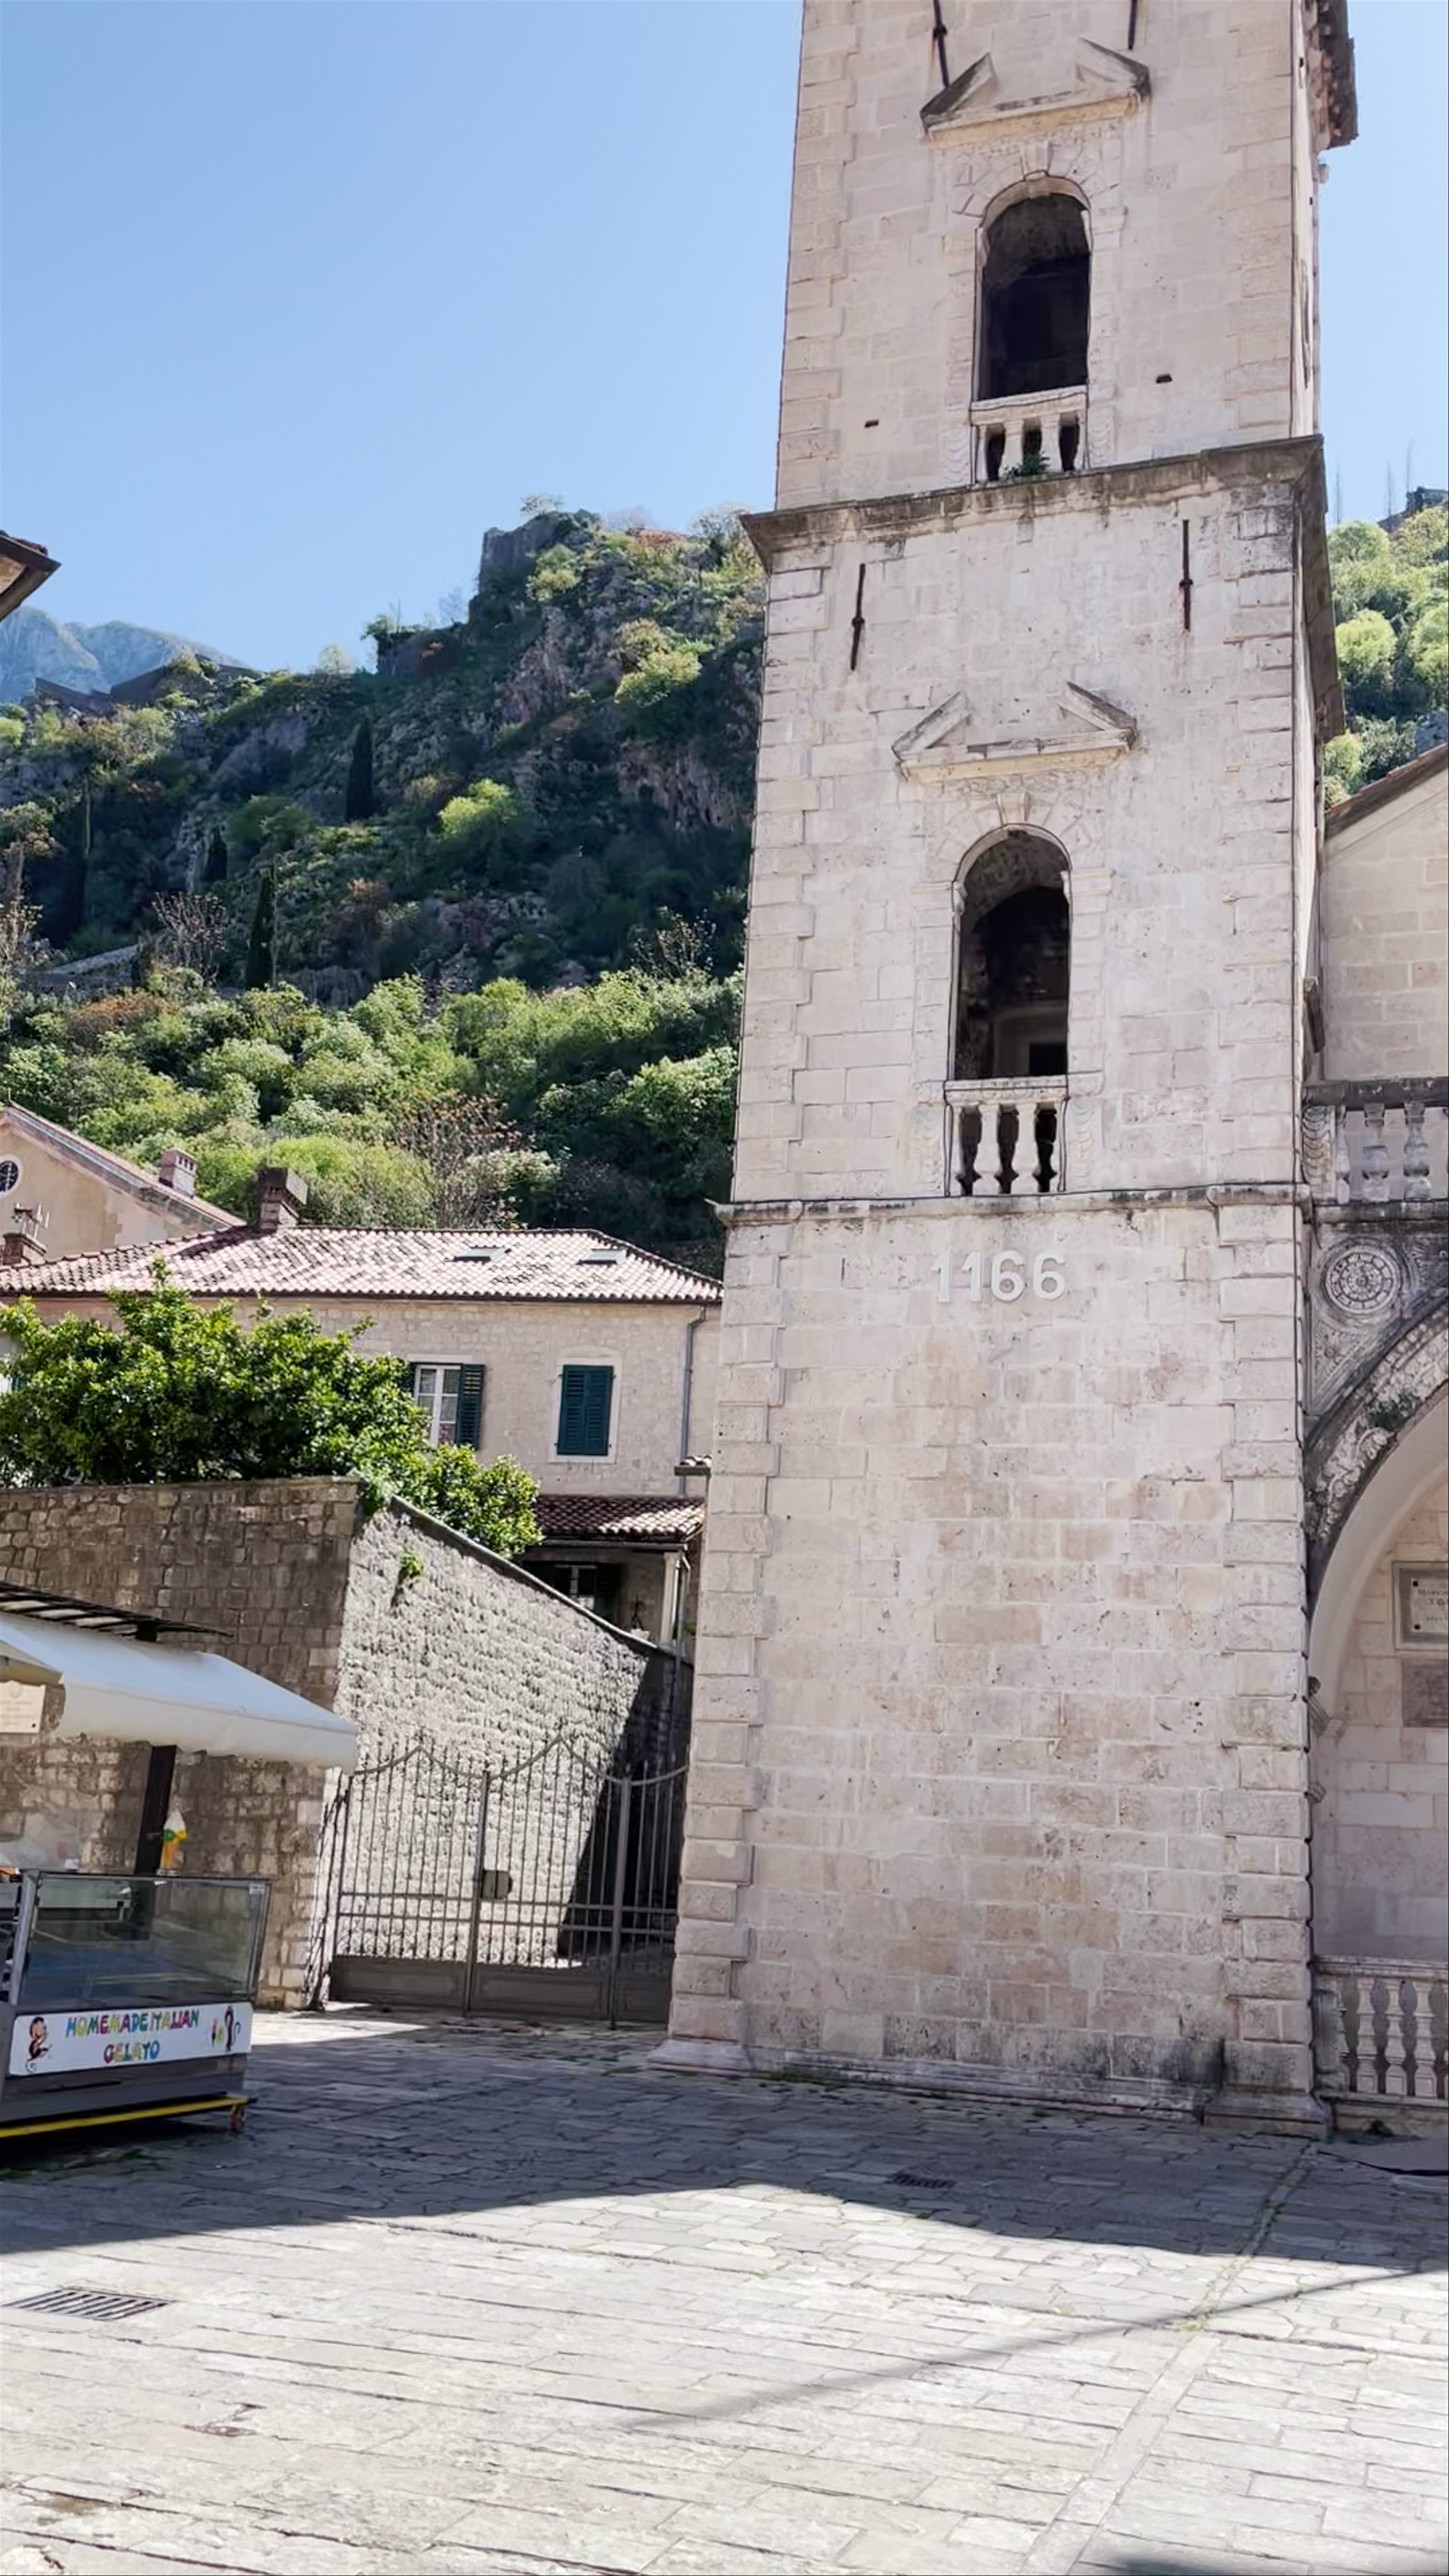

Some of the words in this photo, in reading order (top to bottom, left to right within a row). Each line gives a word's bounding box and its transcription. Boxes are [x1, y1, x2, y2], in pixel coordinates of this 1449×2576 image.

[931, 1249, 1066, 1303] 1166
[65, 2013, 148, 2038] HOMEMADE
[150, 2009, 199, 2032] ITALIAN
[104, 2040, 160, 2064] GELATO
